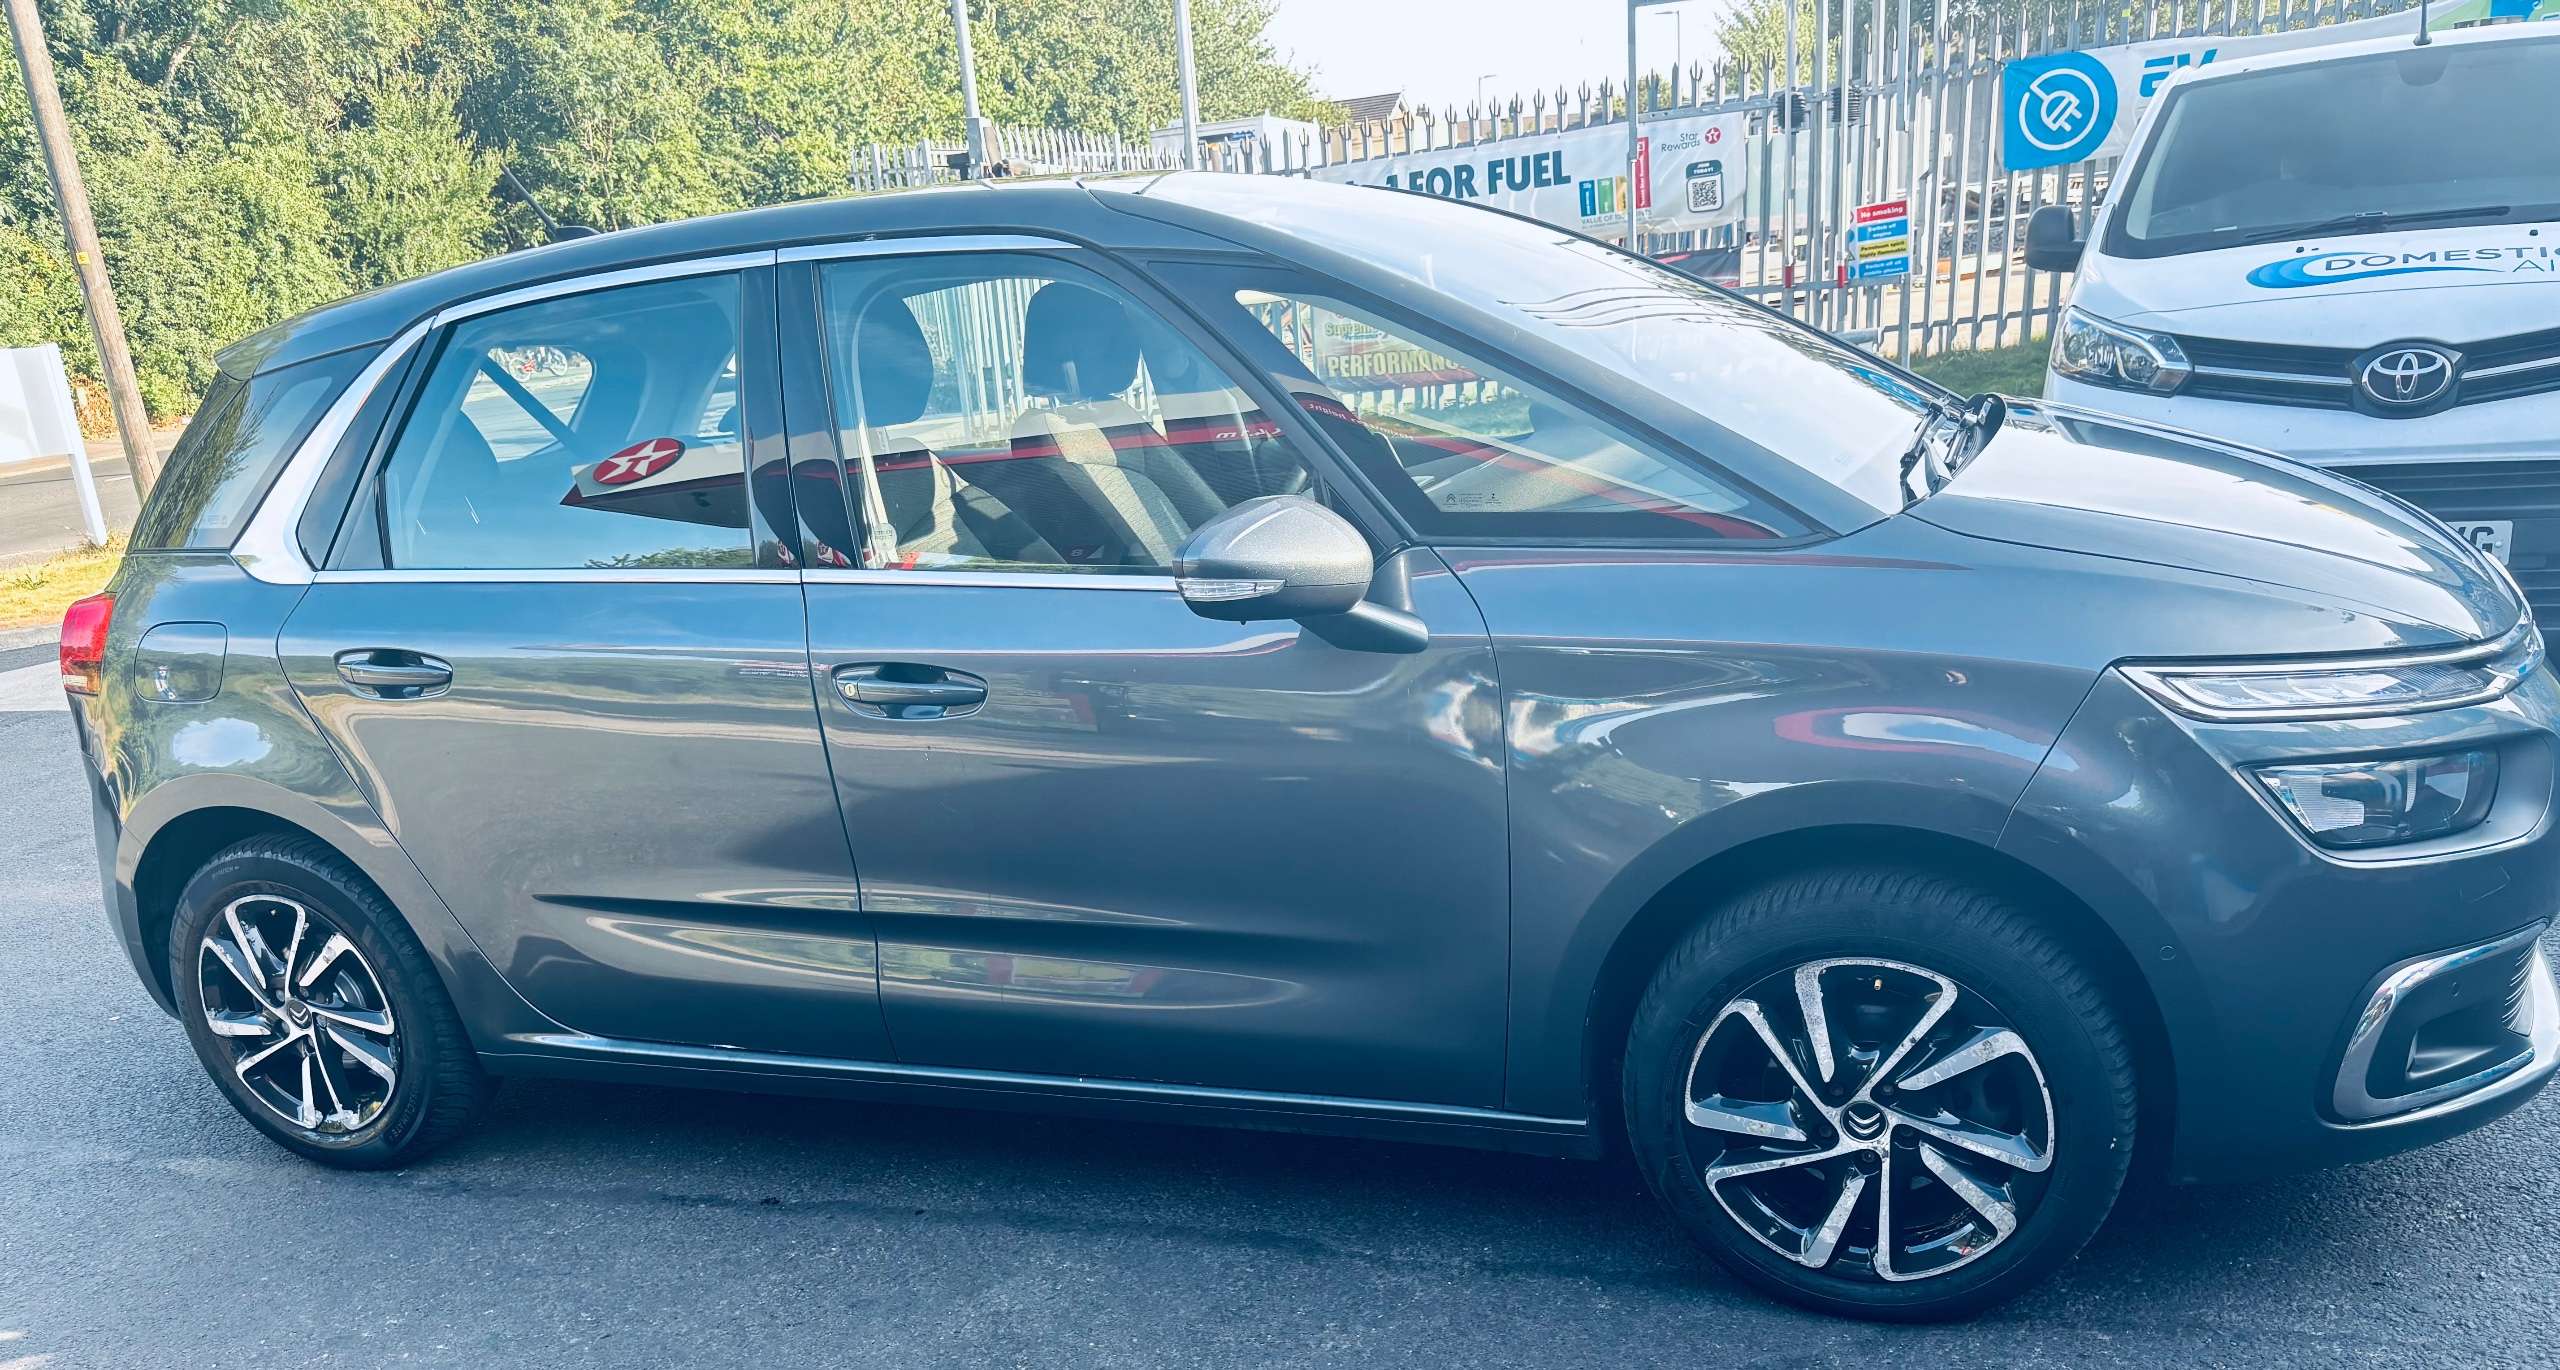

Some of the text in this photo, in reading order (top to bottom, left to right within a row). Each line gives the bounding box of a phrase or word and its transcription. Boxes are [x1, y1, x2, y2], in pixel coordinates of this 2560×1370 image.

[1661, 139, 1701, 152] Rewards
[1680, 133, 1699, 143] Star
[1409, 150, 1572, 199] FOR FUEL
[1860, 206, 1904, 219] No smoking
[2325, 246, 2560, 271] DOMESTI
[1327, 349, 1465, 378] PERFORMANC
